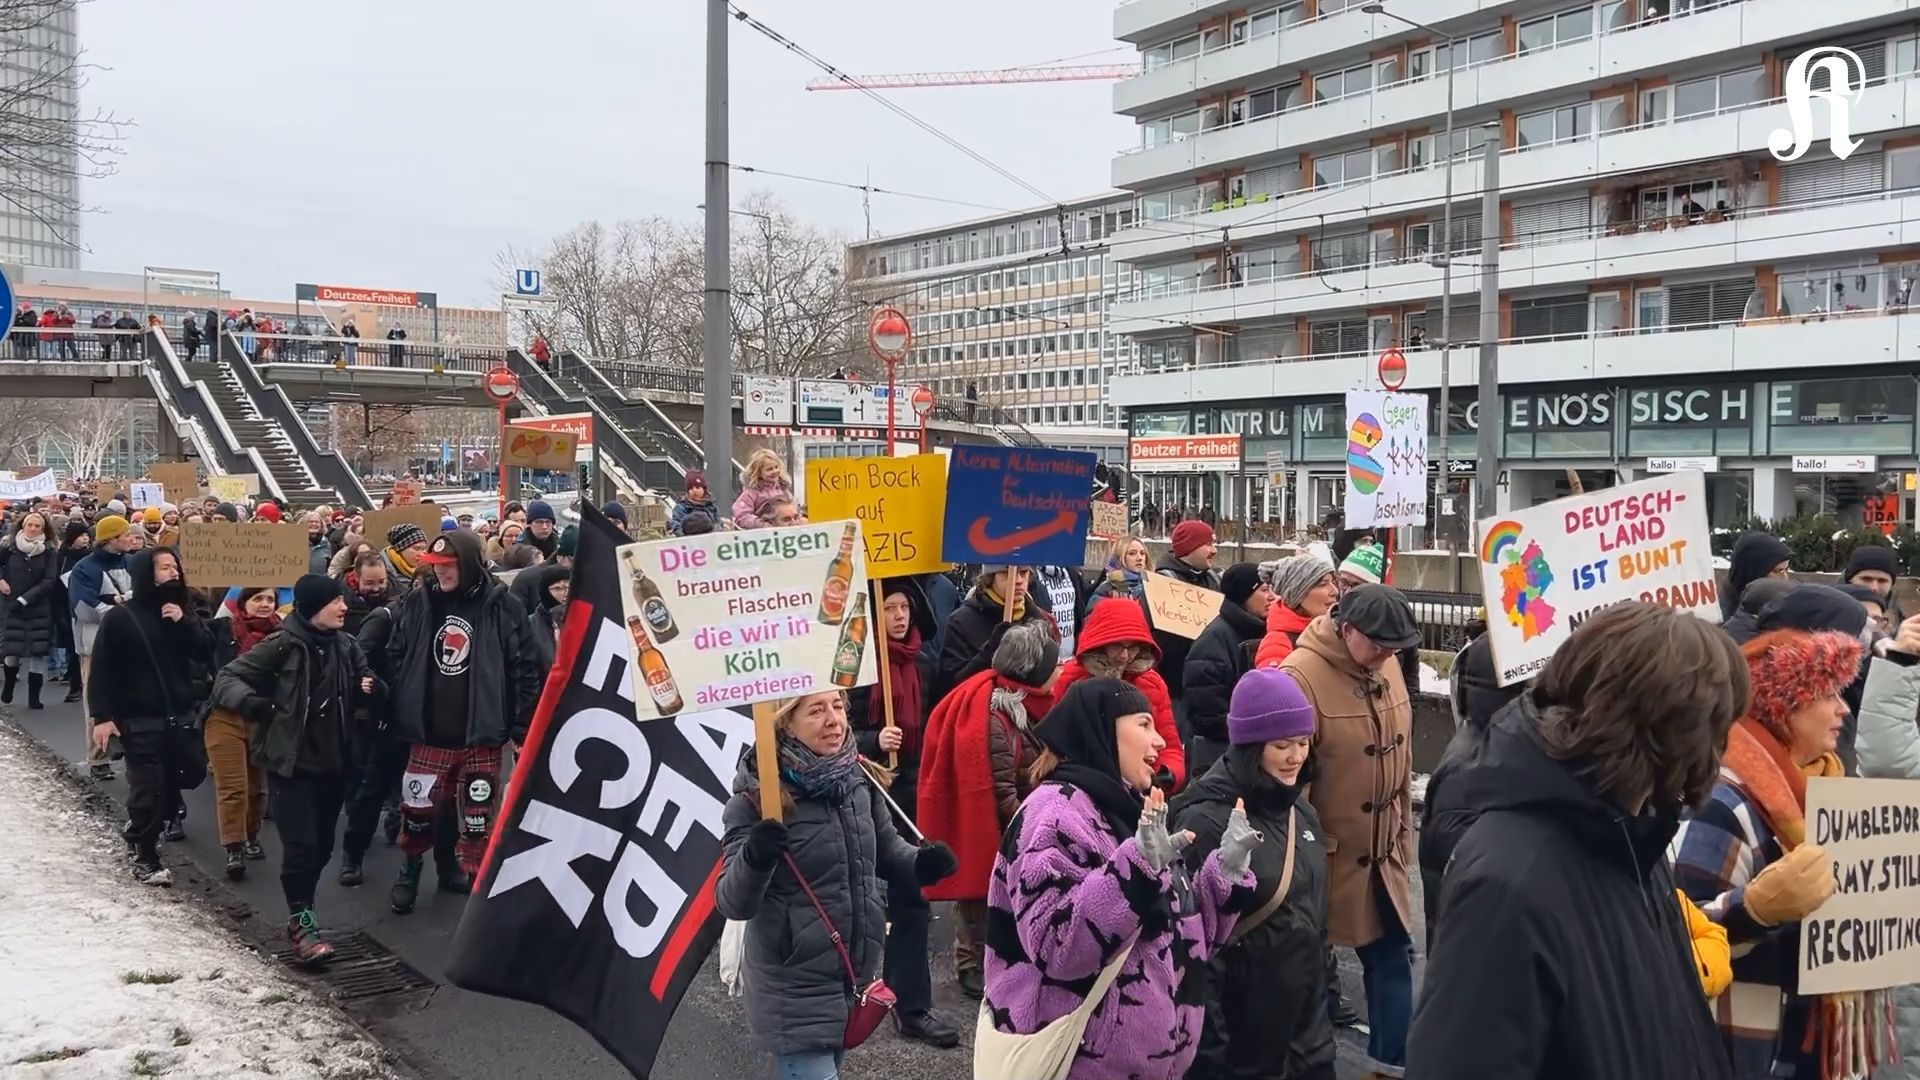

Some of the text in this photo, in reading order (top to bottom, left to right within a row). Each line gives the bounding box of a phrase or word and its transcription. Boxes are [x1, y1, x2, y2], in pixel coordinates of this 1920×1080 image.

[520, 270, 538, 292] U
[323, 288, 412, 305] Deutzer Freiheit
[1382, 395, 1420, 431] Gegen
[957, 449, 1000, 469] Keine
[1132, 441, 1239, 456] Deutzer Freiheit
[1650, 459, 1677, 469] hallo!
[1796, 459, 1827, 469] hallo!
[818, 462, 921, 493] Kein Bock
[1496, 471, 1509, 494] 4
[855, 497, 885, 523] auf
[1374, 491, 1425, 521] Faschismus
[1565, 490, 1686, 534] DEUTSCH-
[185, 524, 217, 537] Ohne
[186, 539, 211, 548] und
[1600, 517, 1665, 552] LAND
[249, 555, 267, 565] der
[660, 530, 830, 573] Die einzigen
[1572, 540, 1688, 591] IST BUNT
[677, 574, 762, 597] braunen
[1169, 582, 1210, 607] FCK
[728, 590, 813, 616] Flaschen
[694, 616, 810, 651] die wir in
[725, 648, 781, 676] Köln
[1504, 656, 1551, 681] #NIEWIED
[696, 673, 813, 706] akzeptieren
[1816, 805, 1920, 846] DUMBLEDOR
[1833, 854, 1920, 894] RMY, STIL
